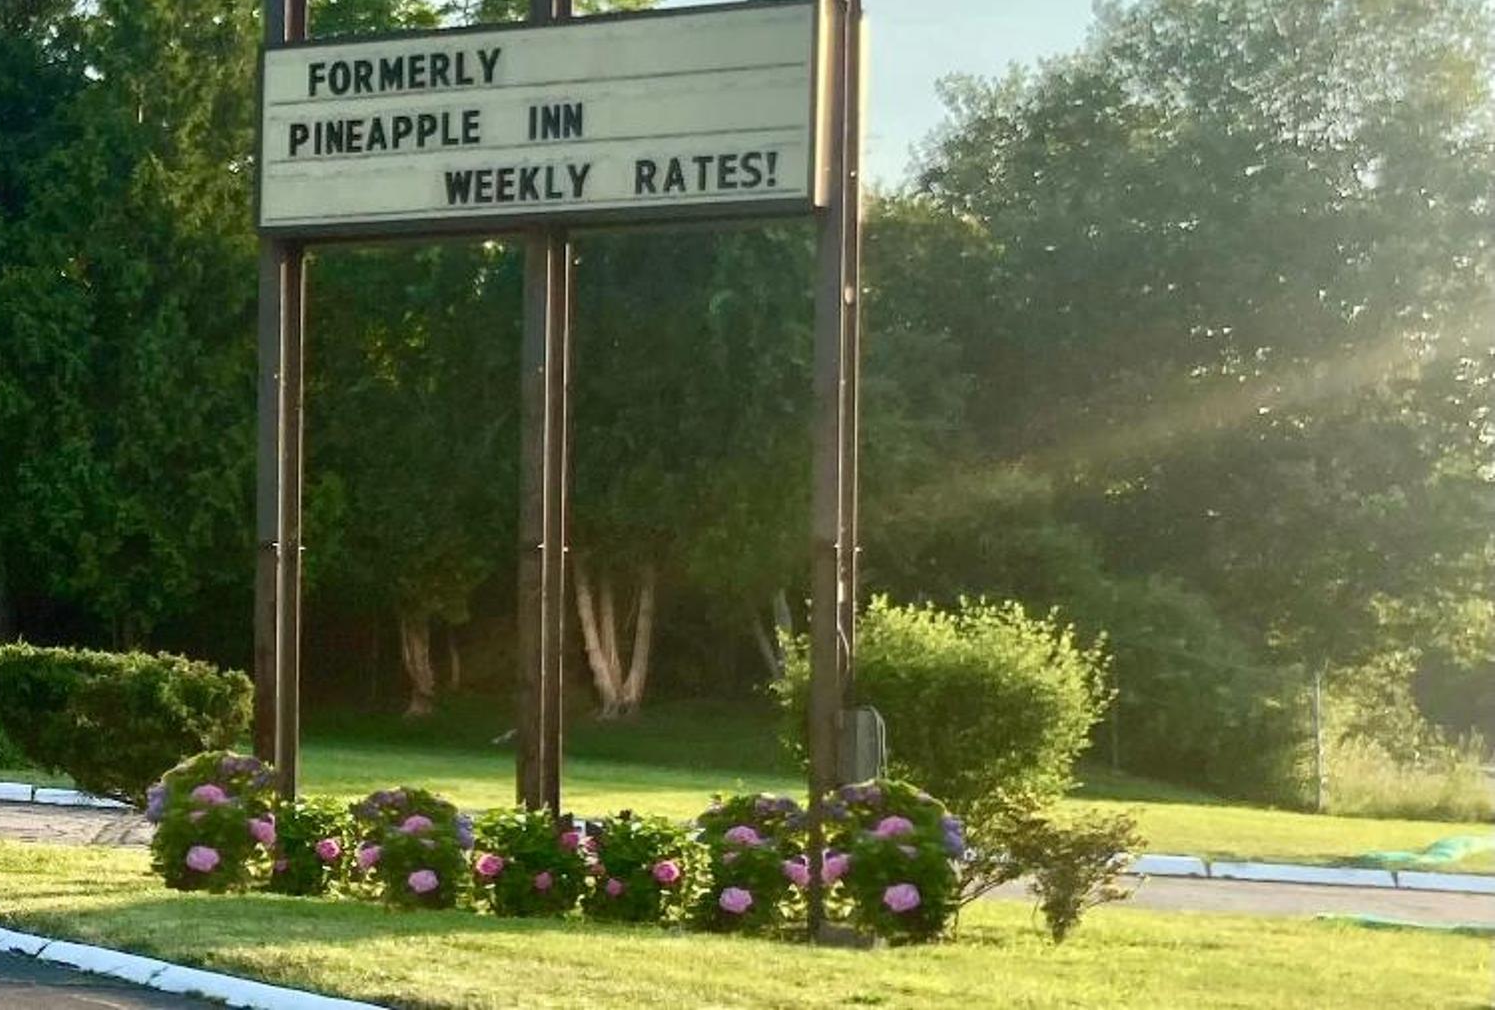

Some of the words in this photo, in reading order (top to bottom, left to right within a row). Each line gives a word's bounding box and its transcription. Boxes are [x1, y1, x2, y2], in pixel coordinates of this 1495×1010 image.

[309, 47, 501, 96] FORMERLY
[289, 110, 480, 157] PINEAPPLE
[528, 102, 583, 141] INN
[445, 163, 590, 204] WEEKLY
[635, 151, 779, 193] RATES!
